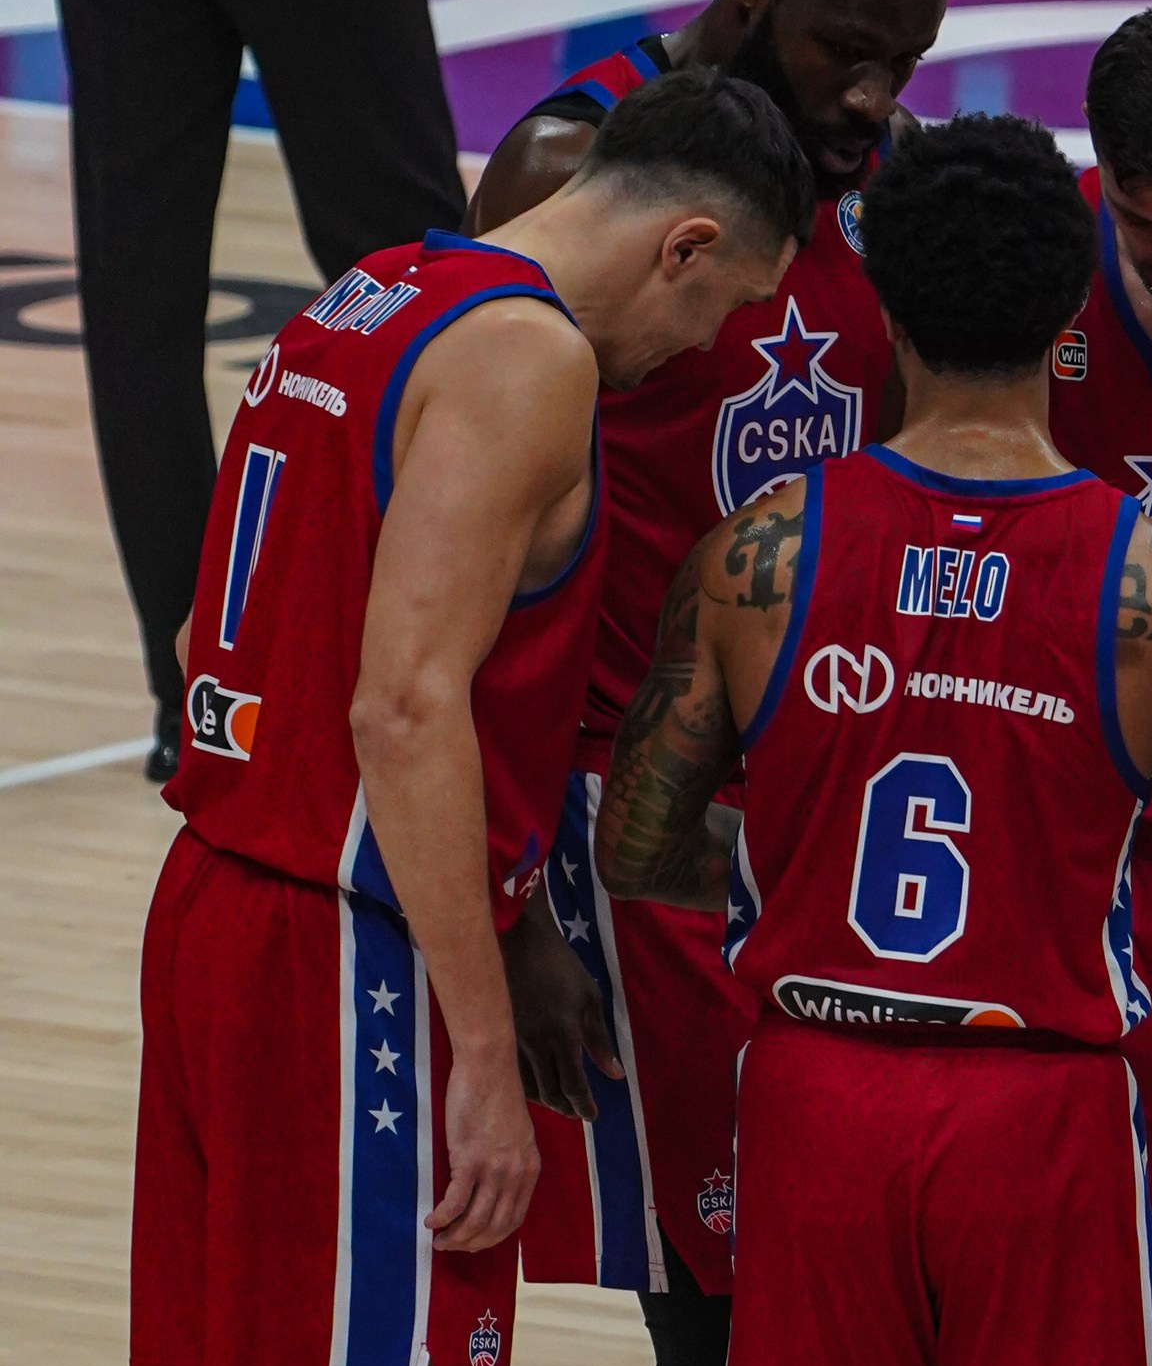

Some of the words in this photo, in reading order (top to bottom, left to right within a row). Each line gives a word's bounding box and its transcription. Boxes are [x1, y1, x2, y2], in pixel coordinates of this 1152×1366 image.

[1061, 347, 1085, 364] Win
[738, 414, 838, 464] CSKA
[896, 544, 1010, 622] MELO
[904, 671, 1075, 725] НОРНИКЕЛЬ
[847, 752, 972, 963] 6
[472, 1337, 497, 1349] CSKA
